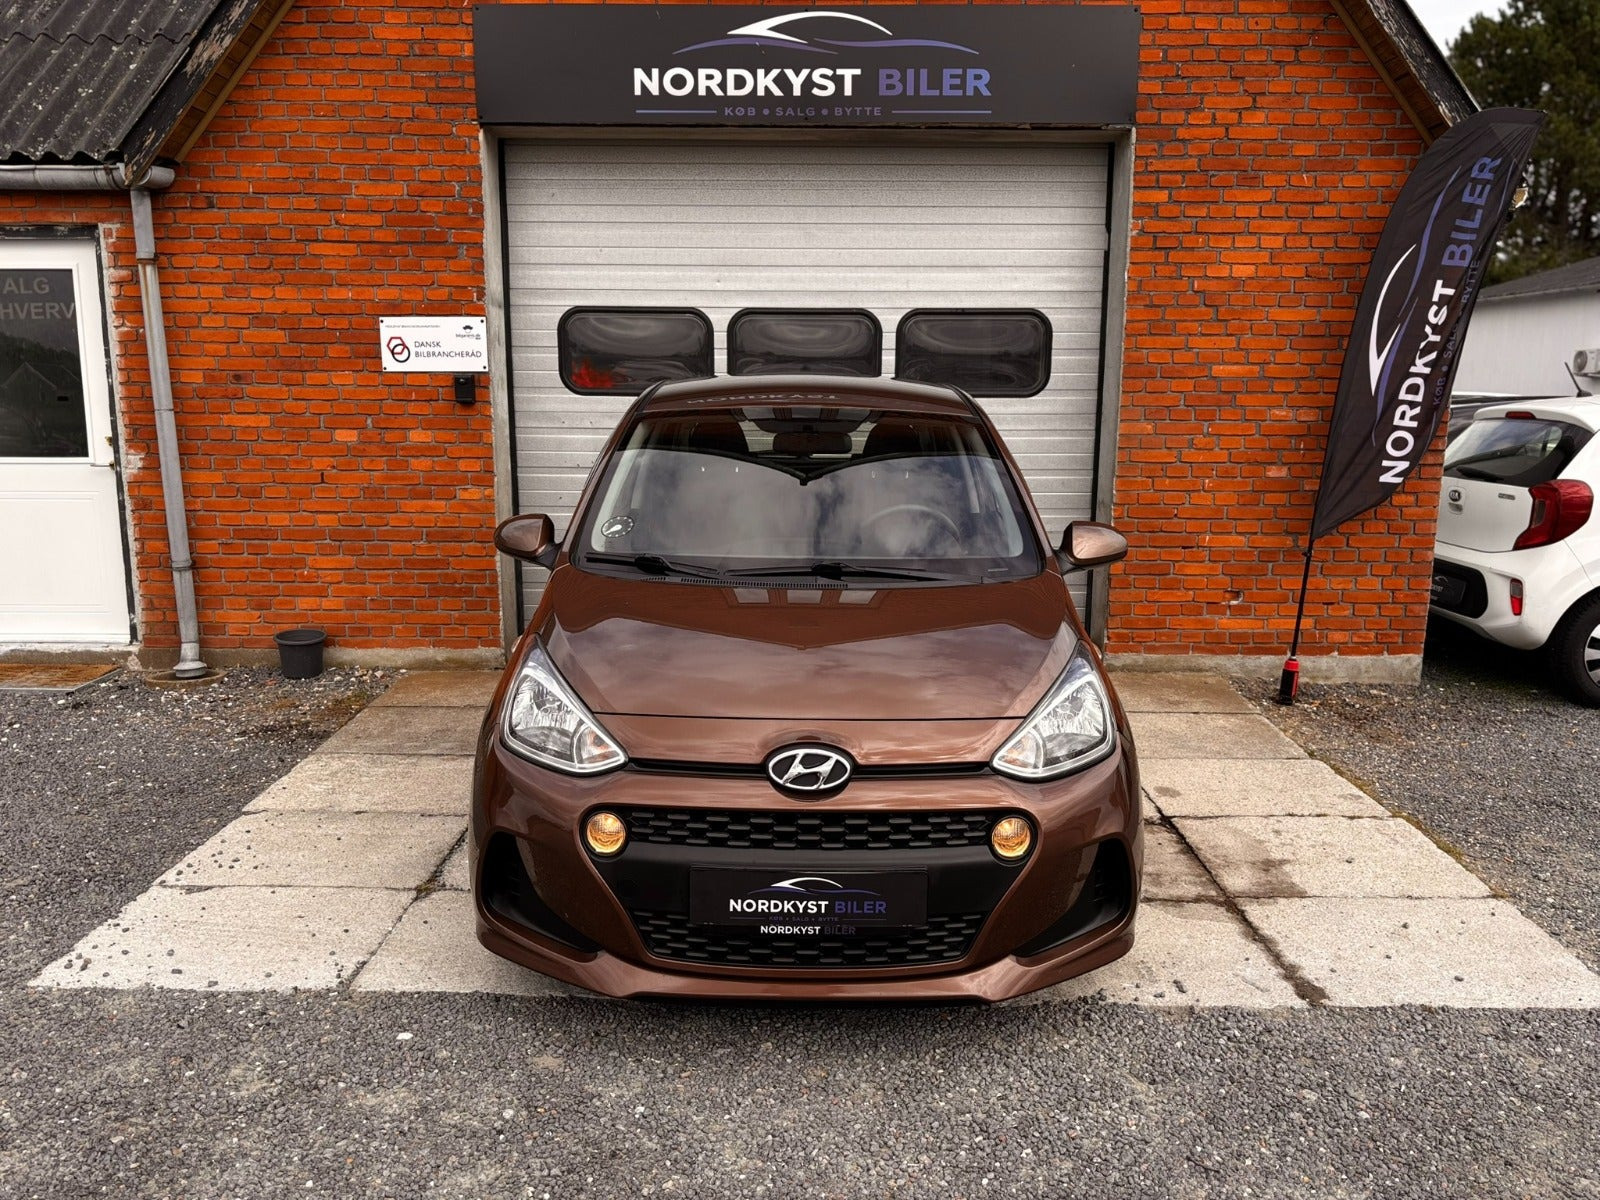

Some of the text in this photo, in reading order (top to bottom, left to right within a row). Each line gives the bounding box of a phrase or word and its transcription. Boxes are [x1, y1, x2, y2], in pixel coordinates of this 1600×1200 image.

[633, 67, 992, 97] NORDKYST BILER
[724, 106, 883, 117] KØB SALG BYTTE
[0, 302, 76, 320] HVERV
[1378, 155, 1503, 484] NORDKYST BILER
[414, 340, 442, 348] DANSK
[414, 349, 482, 358] BILBRANCHERÅD
[1432, 376, 1447, 407] KØB
[729, 898, 887, 914] NORDKYST BILER
[760, 925, 856, 935] NORDKYST BILER
